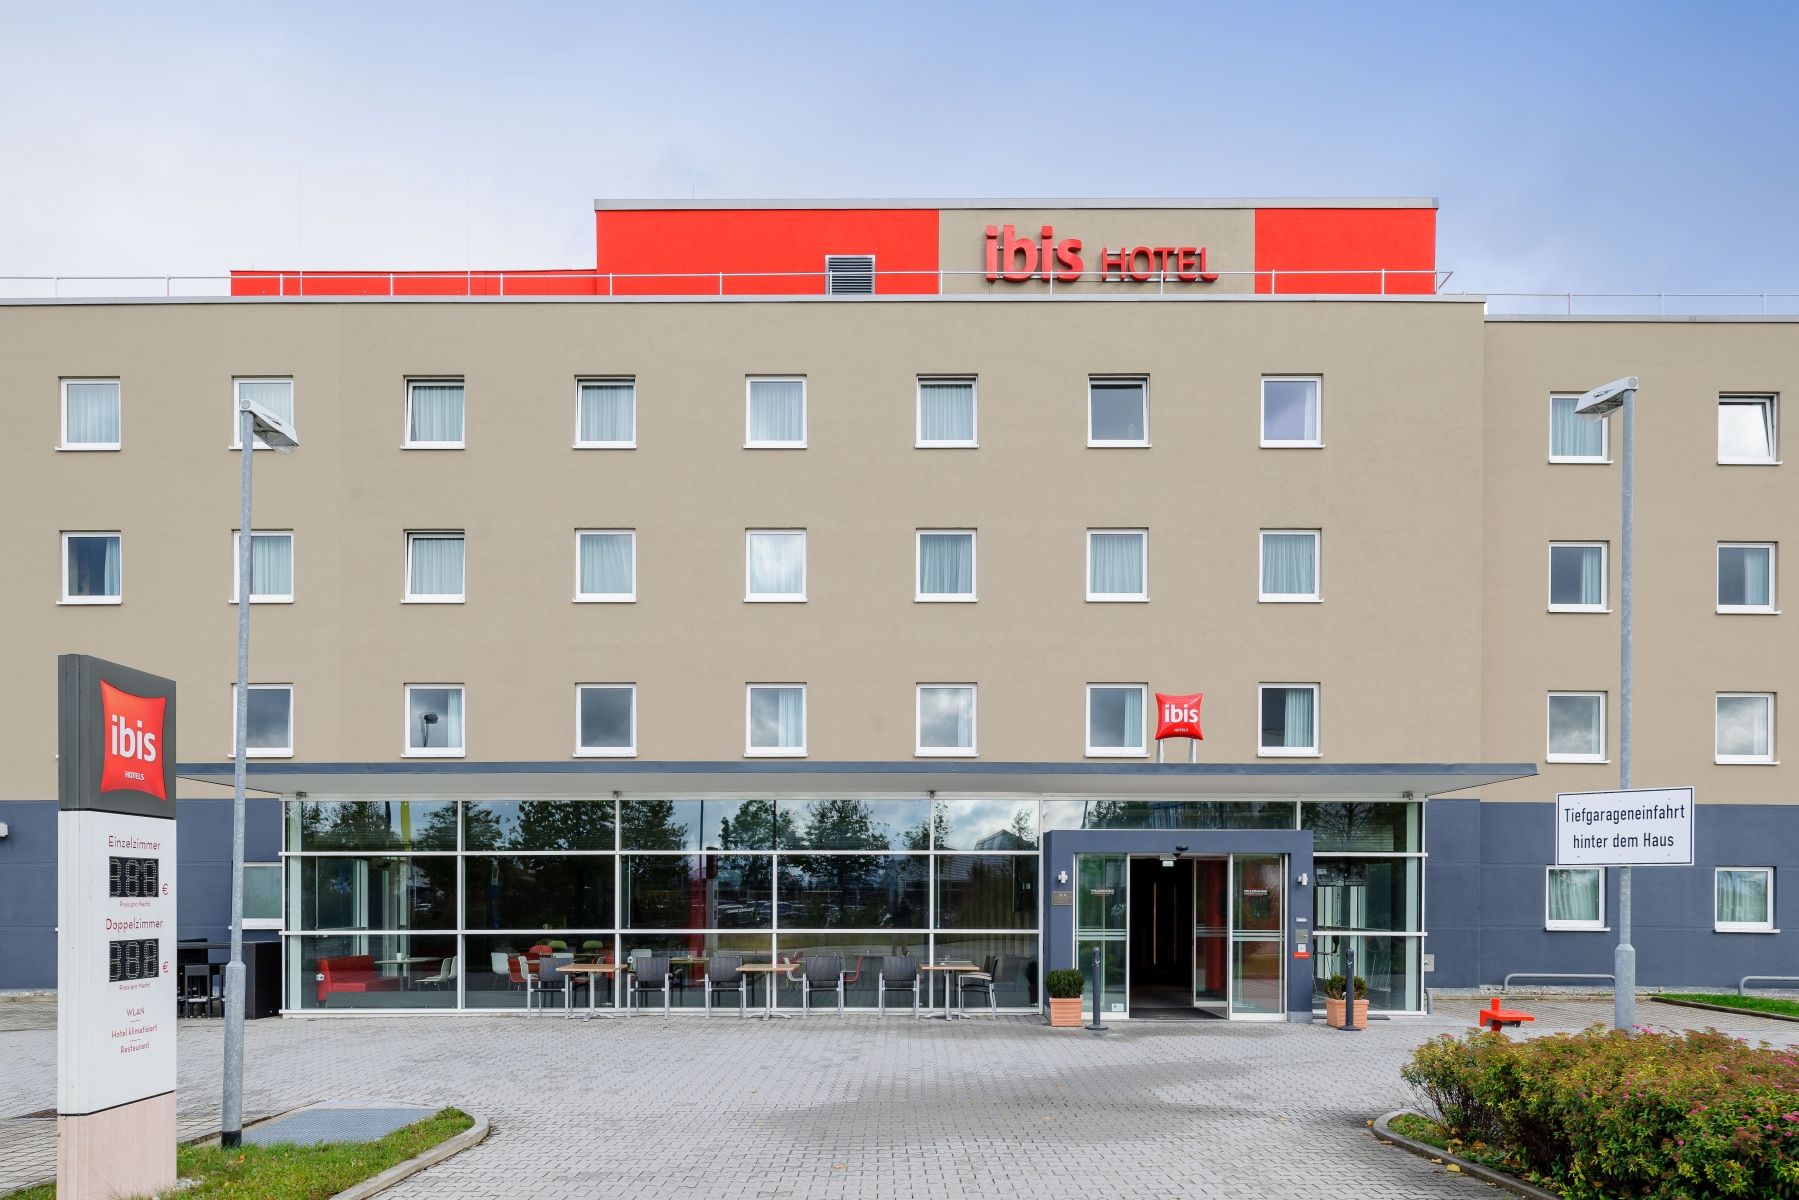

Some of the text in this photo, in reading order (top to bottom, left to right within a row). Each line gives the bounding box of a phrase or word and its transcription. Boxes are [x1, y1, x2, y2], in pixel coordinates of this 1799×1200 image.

[985, 224, 1219, 282] ibis HOTEL
[1164, 703, 1199, 723] ibis
[111, 714, 156, 762] ibis
[125, 771, 145, 781] HOTELS
[1564, 804, 1685, 825] Tiefgarageneinfahrt
[108, 835, 160, 850] Einzelzimmer
[1573, 832, 1674, 848] hinter dem Haus
[106, 917, 163, 933] Doppelzimmer
[126, 1006, 145, 1016] WLAN
[111, 1024, 158, 1038] Hotel klimatisiert
[120, 1042, 150, 1054] Restaurant
